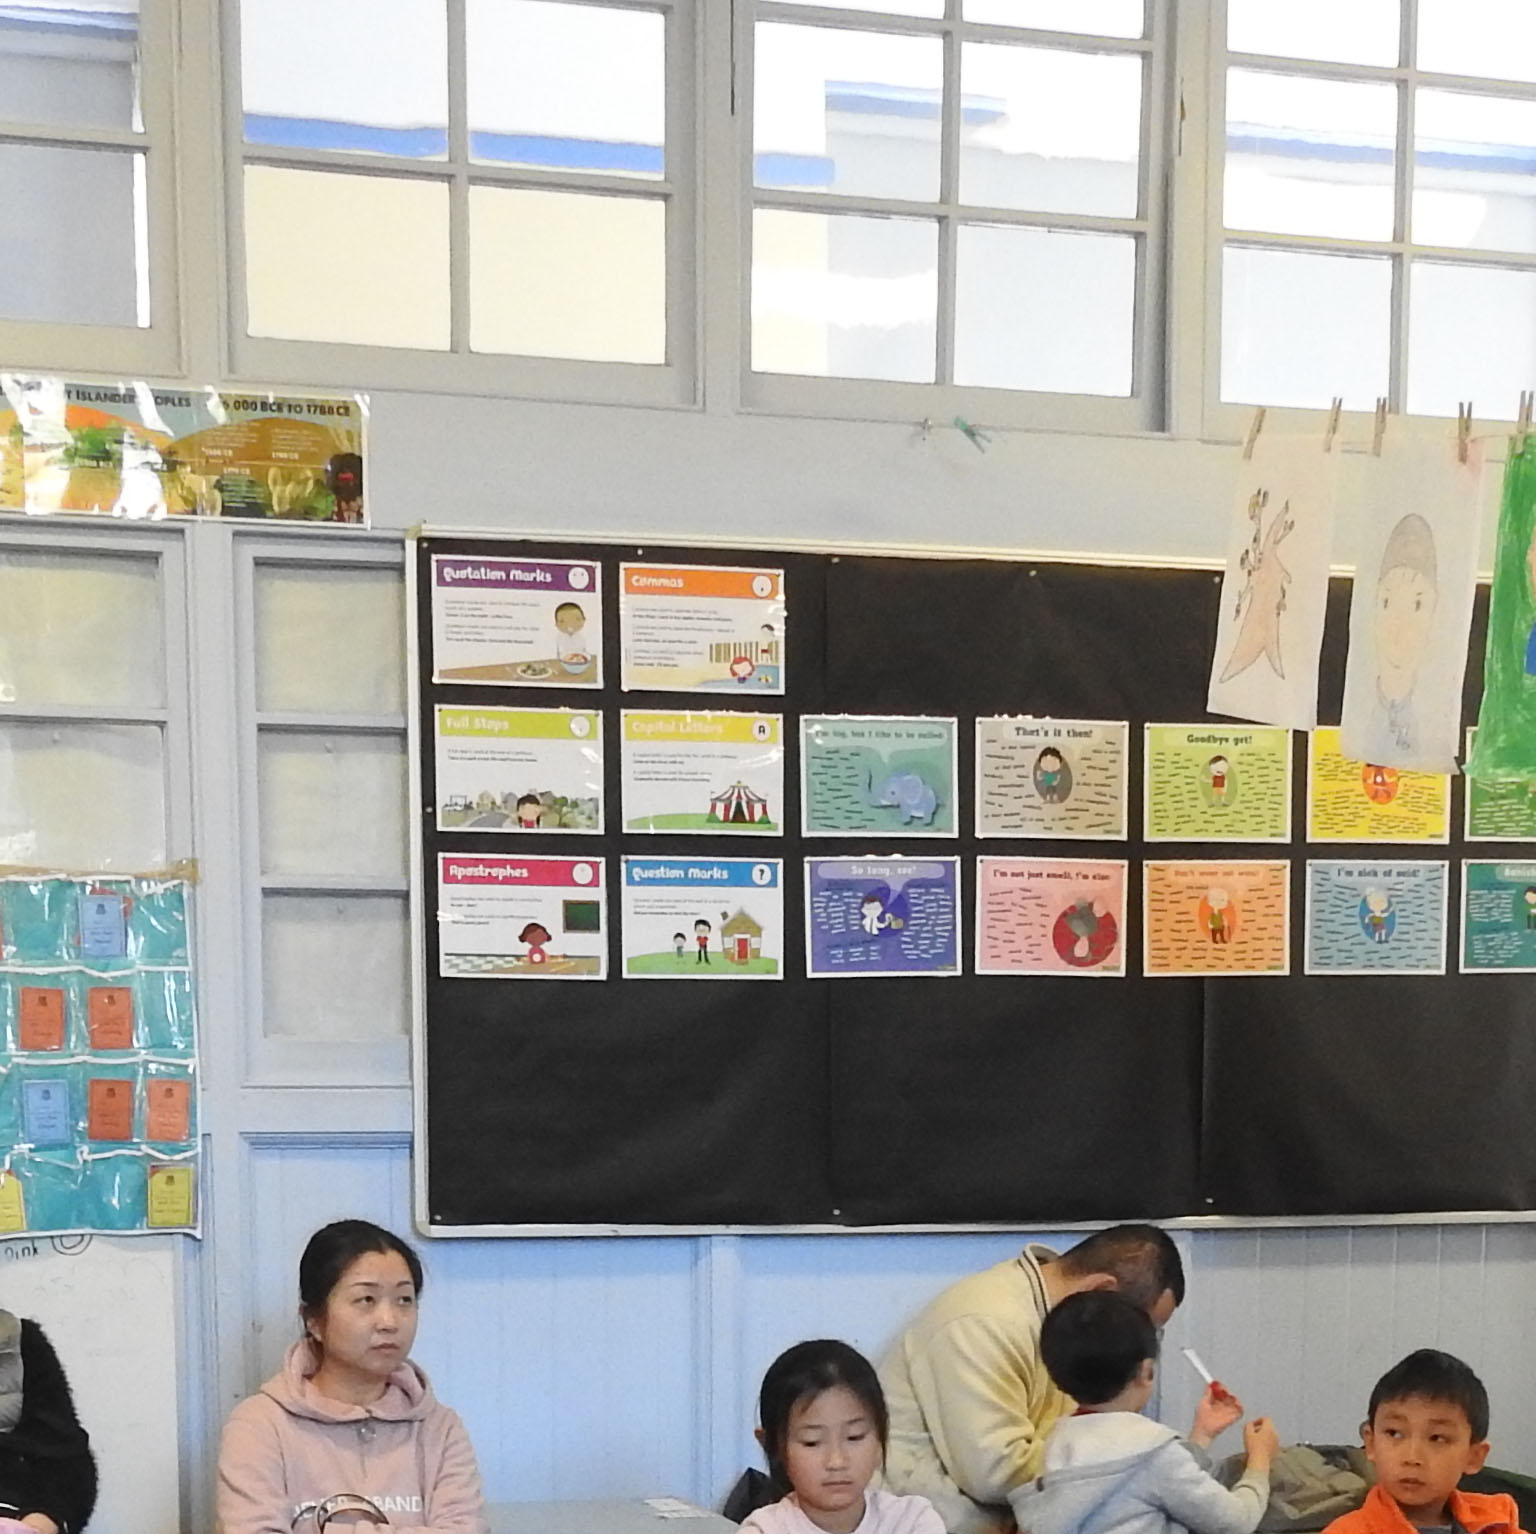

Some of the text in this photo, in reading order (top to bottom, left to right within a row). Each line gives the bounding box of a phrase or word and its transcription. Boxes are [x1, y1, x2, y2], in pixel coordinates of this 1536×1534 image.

[261, 400, 284, 414] BCE
[286, 404, 303, 415] TO
[306, 404, 334, 417] 1788
[335, 405, 351, 417] CE
[442, 567, 552, 583] Quotation Marks
[631, 575, 684, 589] Commas
[446, 717, 510, 733] Full Stops
[631, 720, 724, 737] Capital Letters
[1014, 726, 1093, 739] That's it then!
[1186, 734, 1230, 746] Goodbye
[448, 864, 529, 880] Apostrophes
[631, 866, 728, 882] Question Marks
